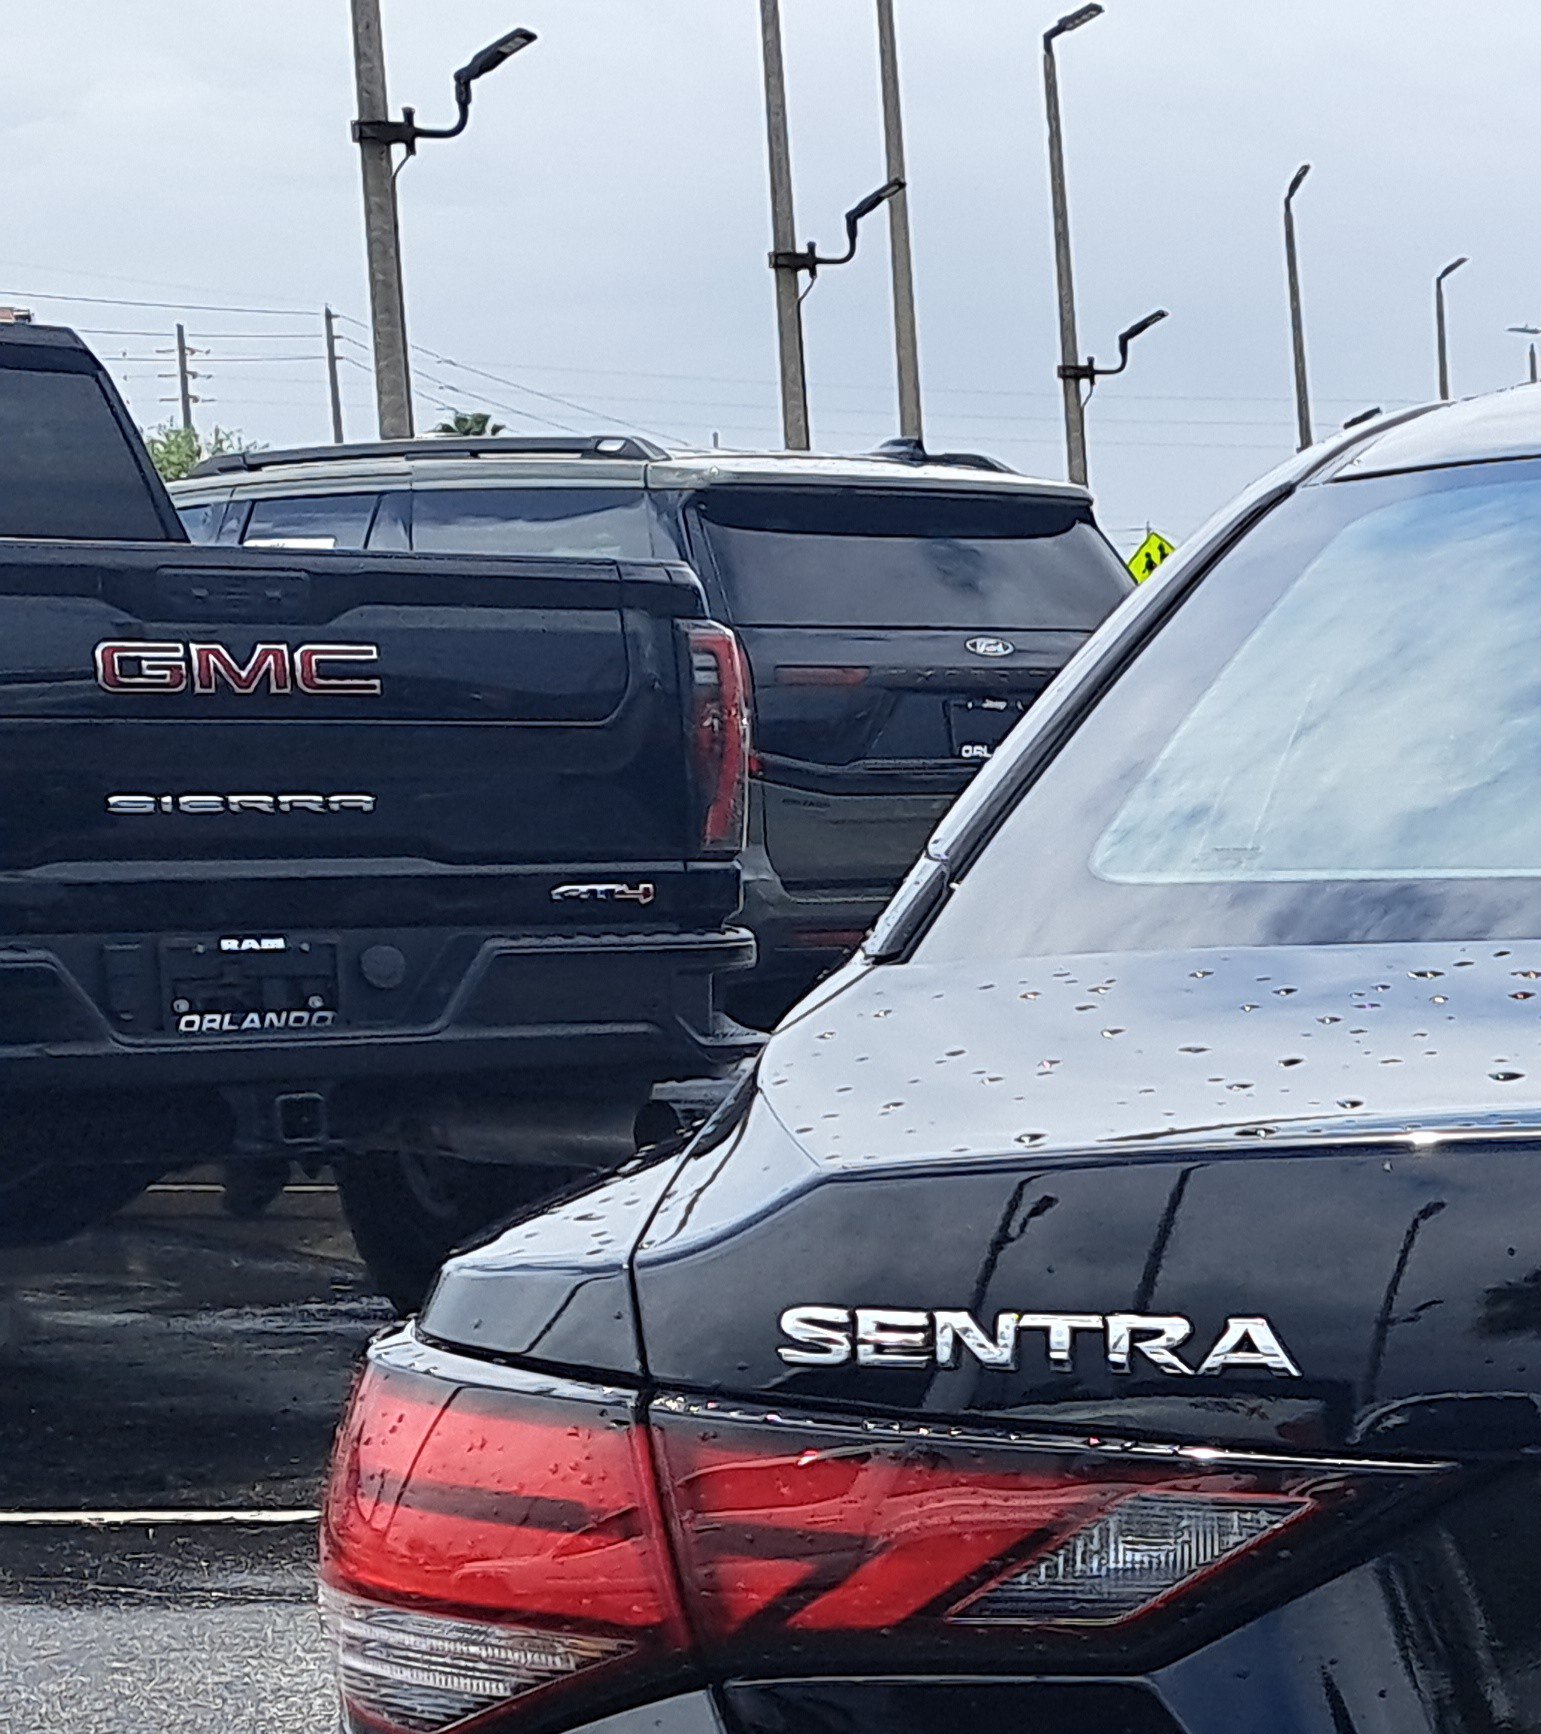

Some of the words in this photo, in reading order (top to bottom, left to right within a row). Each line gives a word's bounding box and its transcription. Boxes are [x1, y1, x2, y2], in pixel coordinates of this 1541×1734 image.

[94, 640, 382, 695] GMC
[106, 794, 376, 814] SIERRA
[220, 938, 285, 951] RAM
[178, 1010, 336, 1033] ORLANDO
[776, 1306, 1301, 1377] SENTRA
